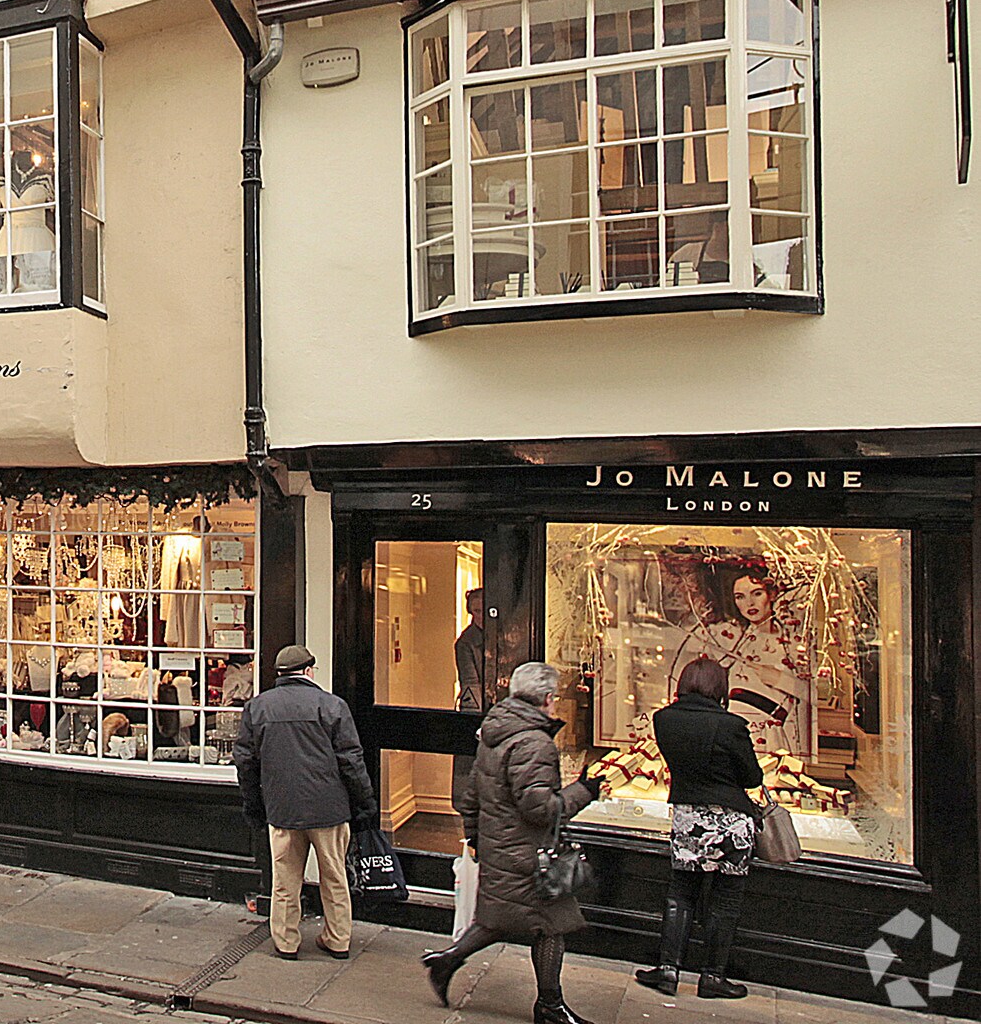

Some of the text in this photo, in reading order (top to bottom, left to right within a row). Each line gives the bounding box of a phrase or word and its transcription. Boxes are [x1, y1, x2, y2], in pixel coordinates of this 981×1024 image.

[411, 493, 433, 510] 25
[666, 496, 771, 513] LONDON
[217, 520, 232, 528] Molly
